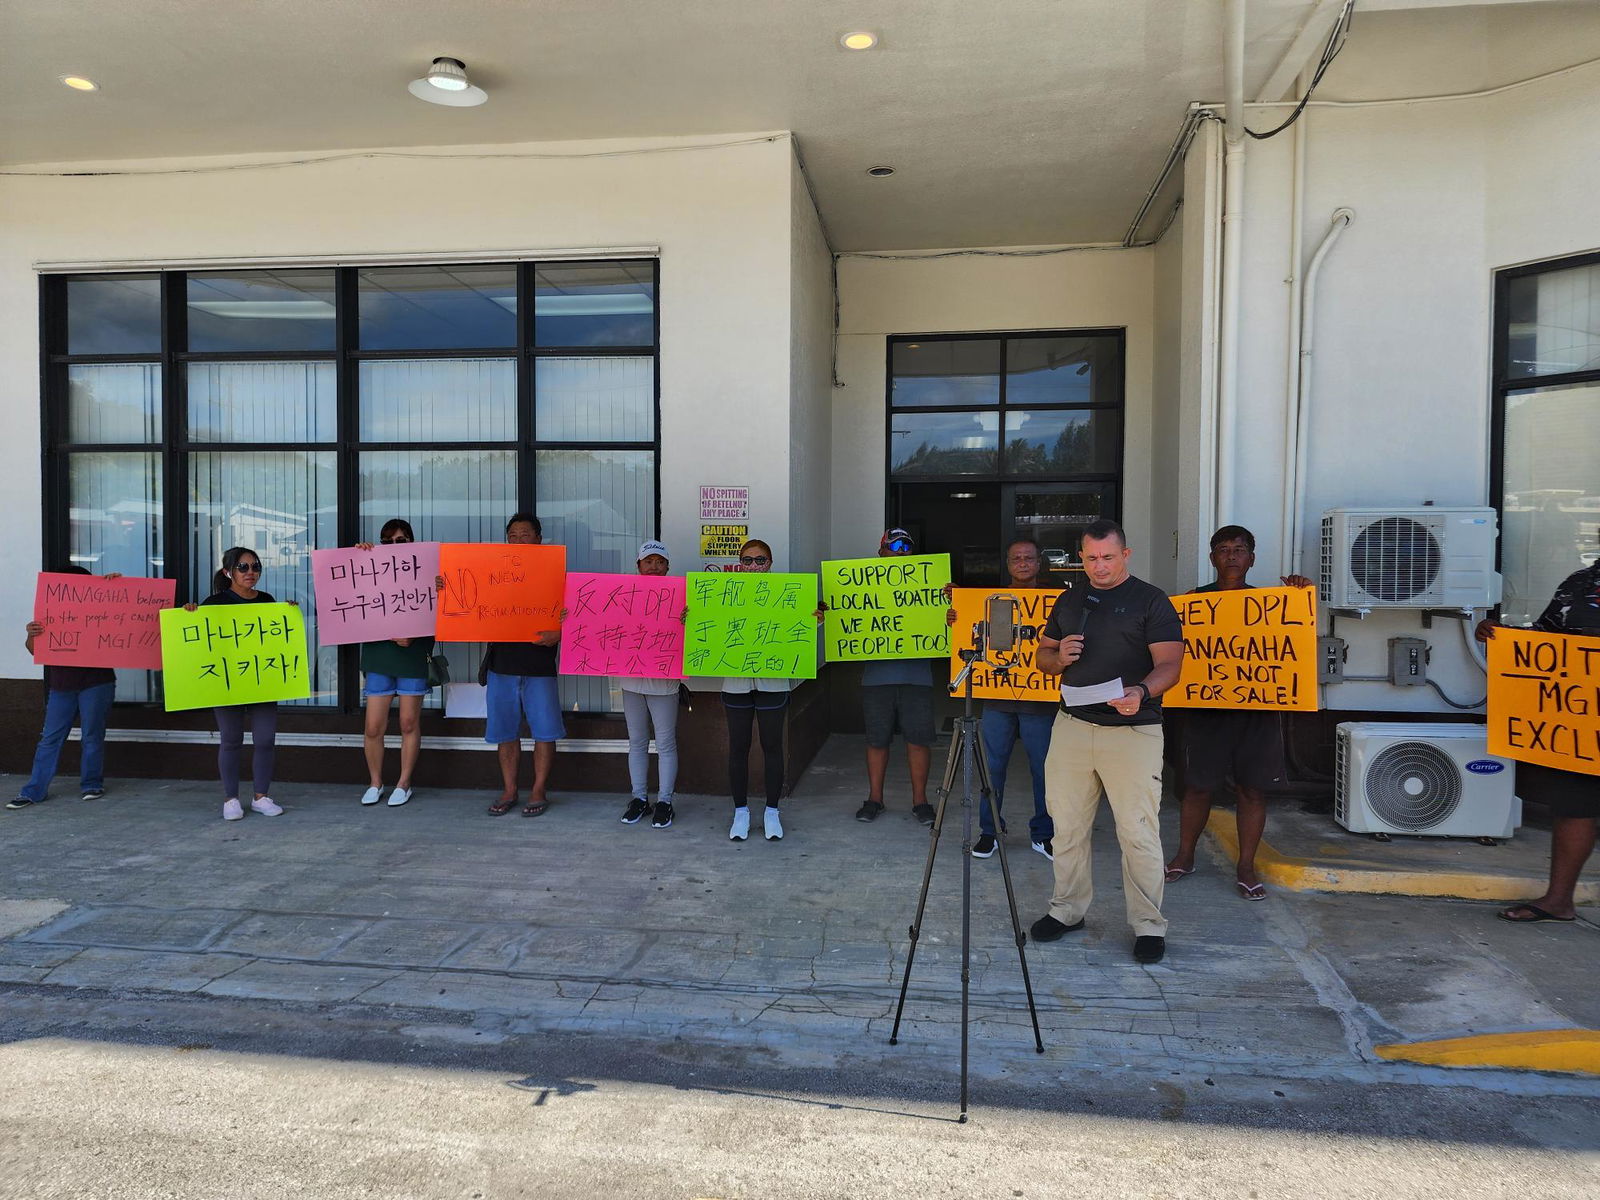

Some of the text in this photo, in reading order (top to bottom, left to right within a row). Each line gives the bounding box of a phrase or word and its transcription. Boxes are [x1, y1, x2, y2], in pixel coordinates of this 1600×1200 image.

[702, 488, 747, 499] NO SPITTING
[702, 500, 747, 509] OF BETELNUT
[702, 509, 740, 518] ANY PLACE
[703, 525, 746, 535] CAUTION
[330, 555, 421, 589] 마나가하
[489, 571, 526, 586] NEW
[837, 561, 933, 586] SUPPORT
[46, 583, 171, 609] MANAGAHA belongs
[443, 568, 478, 614] NO
[694, 577, 802, 609] 军舰岛属
[831, 593, 885, 610] LOCAL
[331, 587, 436, 623] 누구의 것인가
[1244, 591, 1315, 626] DPL!
[45, 608, 54, 626] to
[59, 610, 78, 625] the
[85, 612, 108, 628] people
[114, 612, 125, 626] of
[840, 615, 904, 634] WE ARE
[49, 631, 81, 648] NOT
[183, 615, 294, 652] 마나가하
[570, 624, 679, 652] 支持当地
[695, 617, 812, 649] 于塞班全
[837, 623, 950, 657] PEOPLE TOO!
[574, 652, 676, 676] 水上公司
[1513, 638, 1568, 677] NO!
[198, 653, 299, 691] 지키자!
[1207, 663, 1283, 684] IS NOT
[1186, 672, 1298, 705] FOR SALE!
[1470, 763, 1500, 771] Carrier
